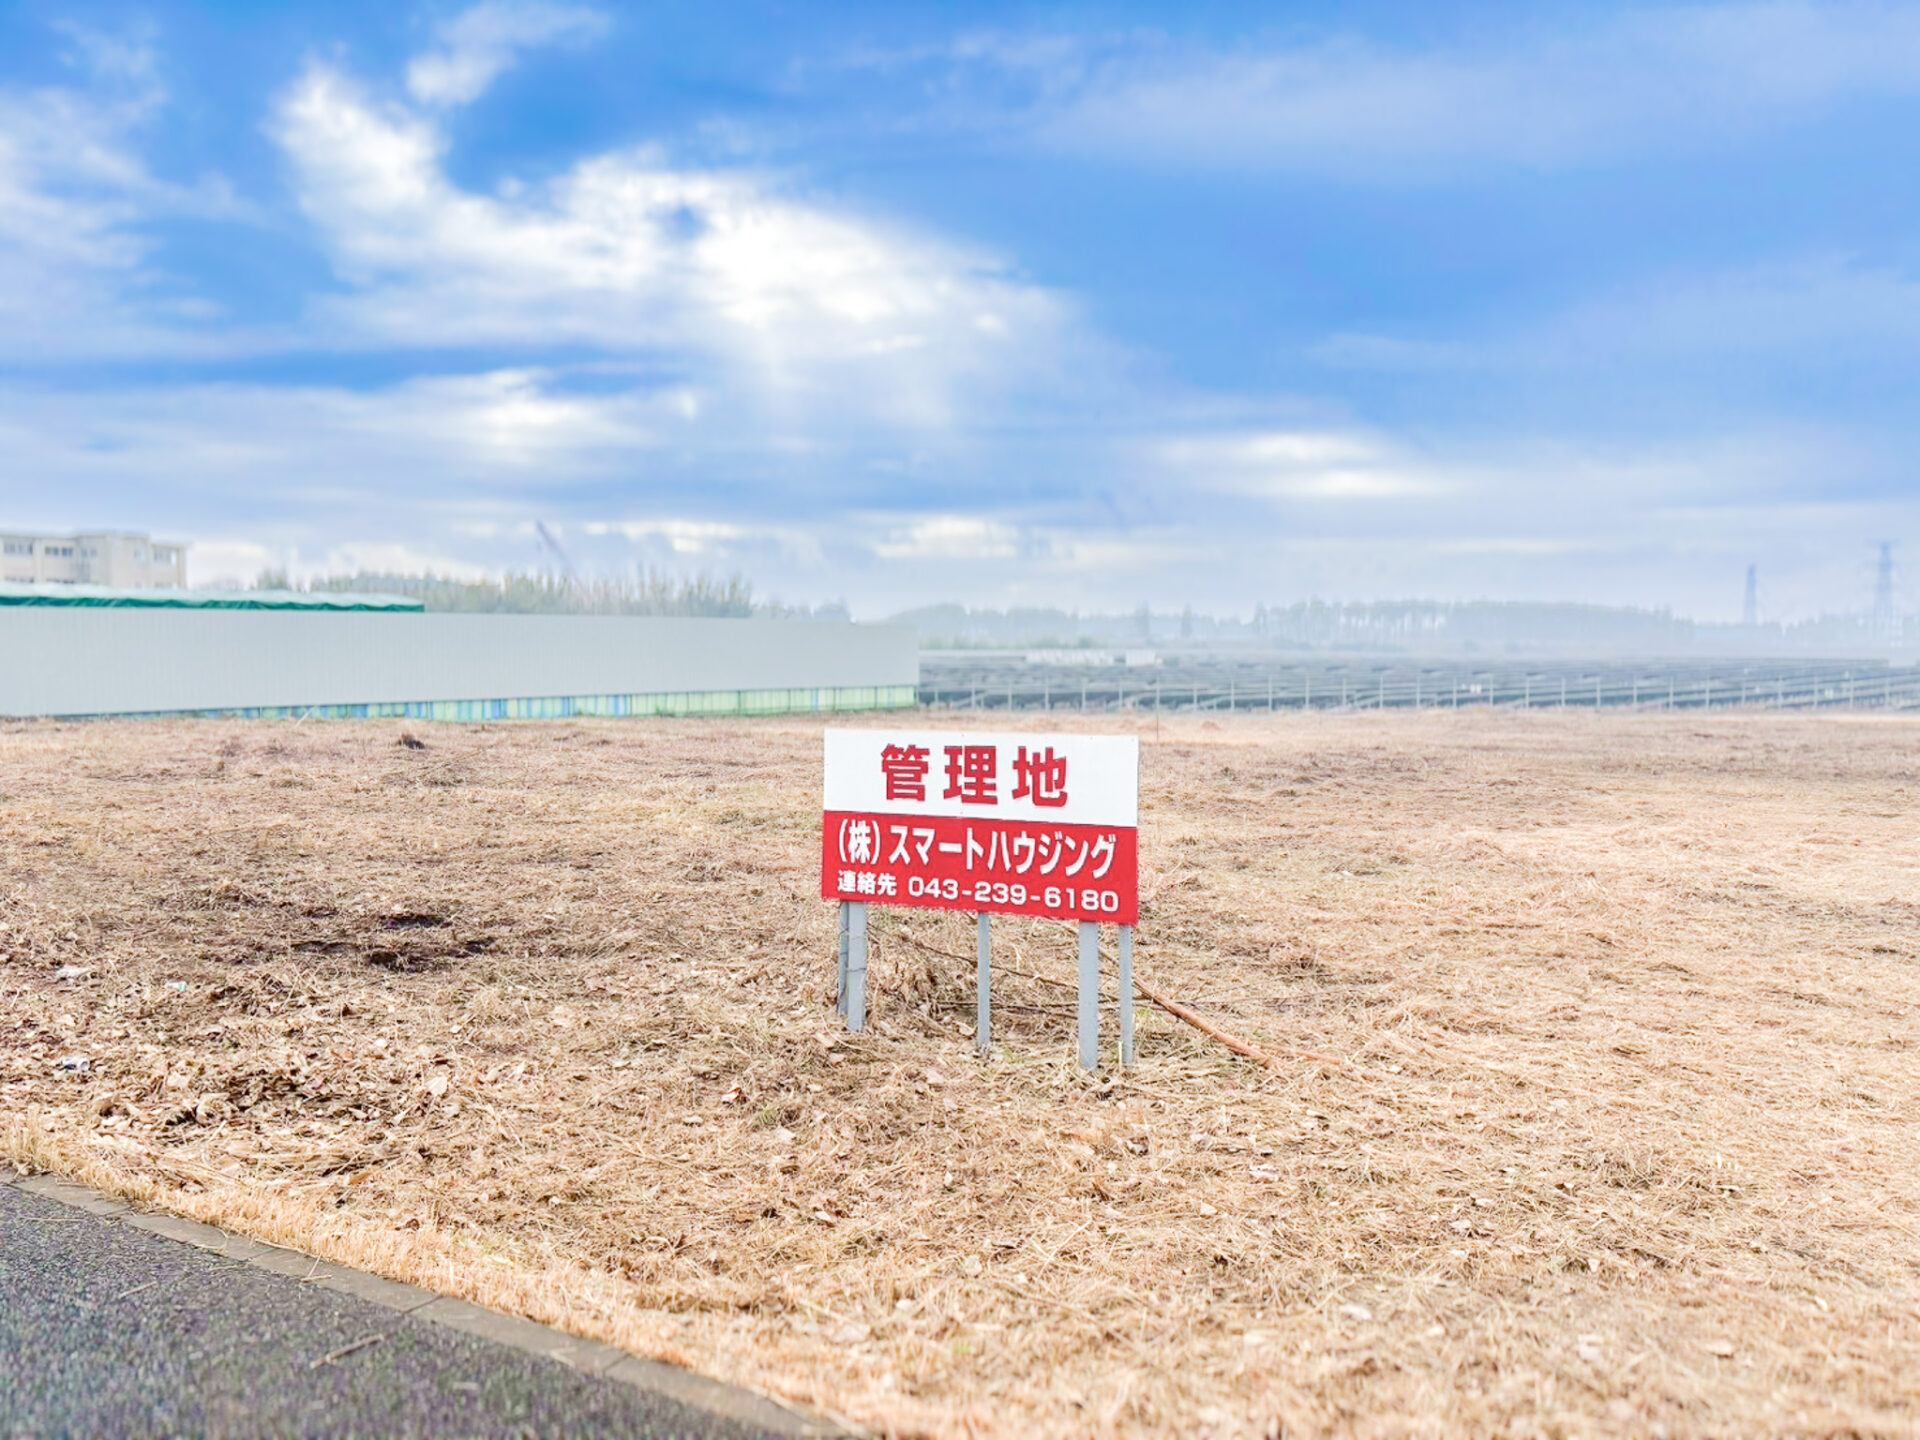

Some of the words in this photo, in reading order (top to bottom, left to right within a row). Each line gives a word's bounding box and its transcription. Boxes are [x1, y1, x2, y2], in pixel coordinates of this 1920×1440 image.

[881, 743, 1068, 807] 管理地
[838, 818, 1117, 879] (株)スマートハウジング
[837, 869, 897, 897] 連絡先
[908, 875, 1119, 913] 043-239-6180
